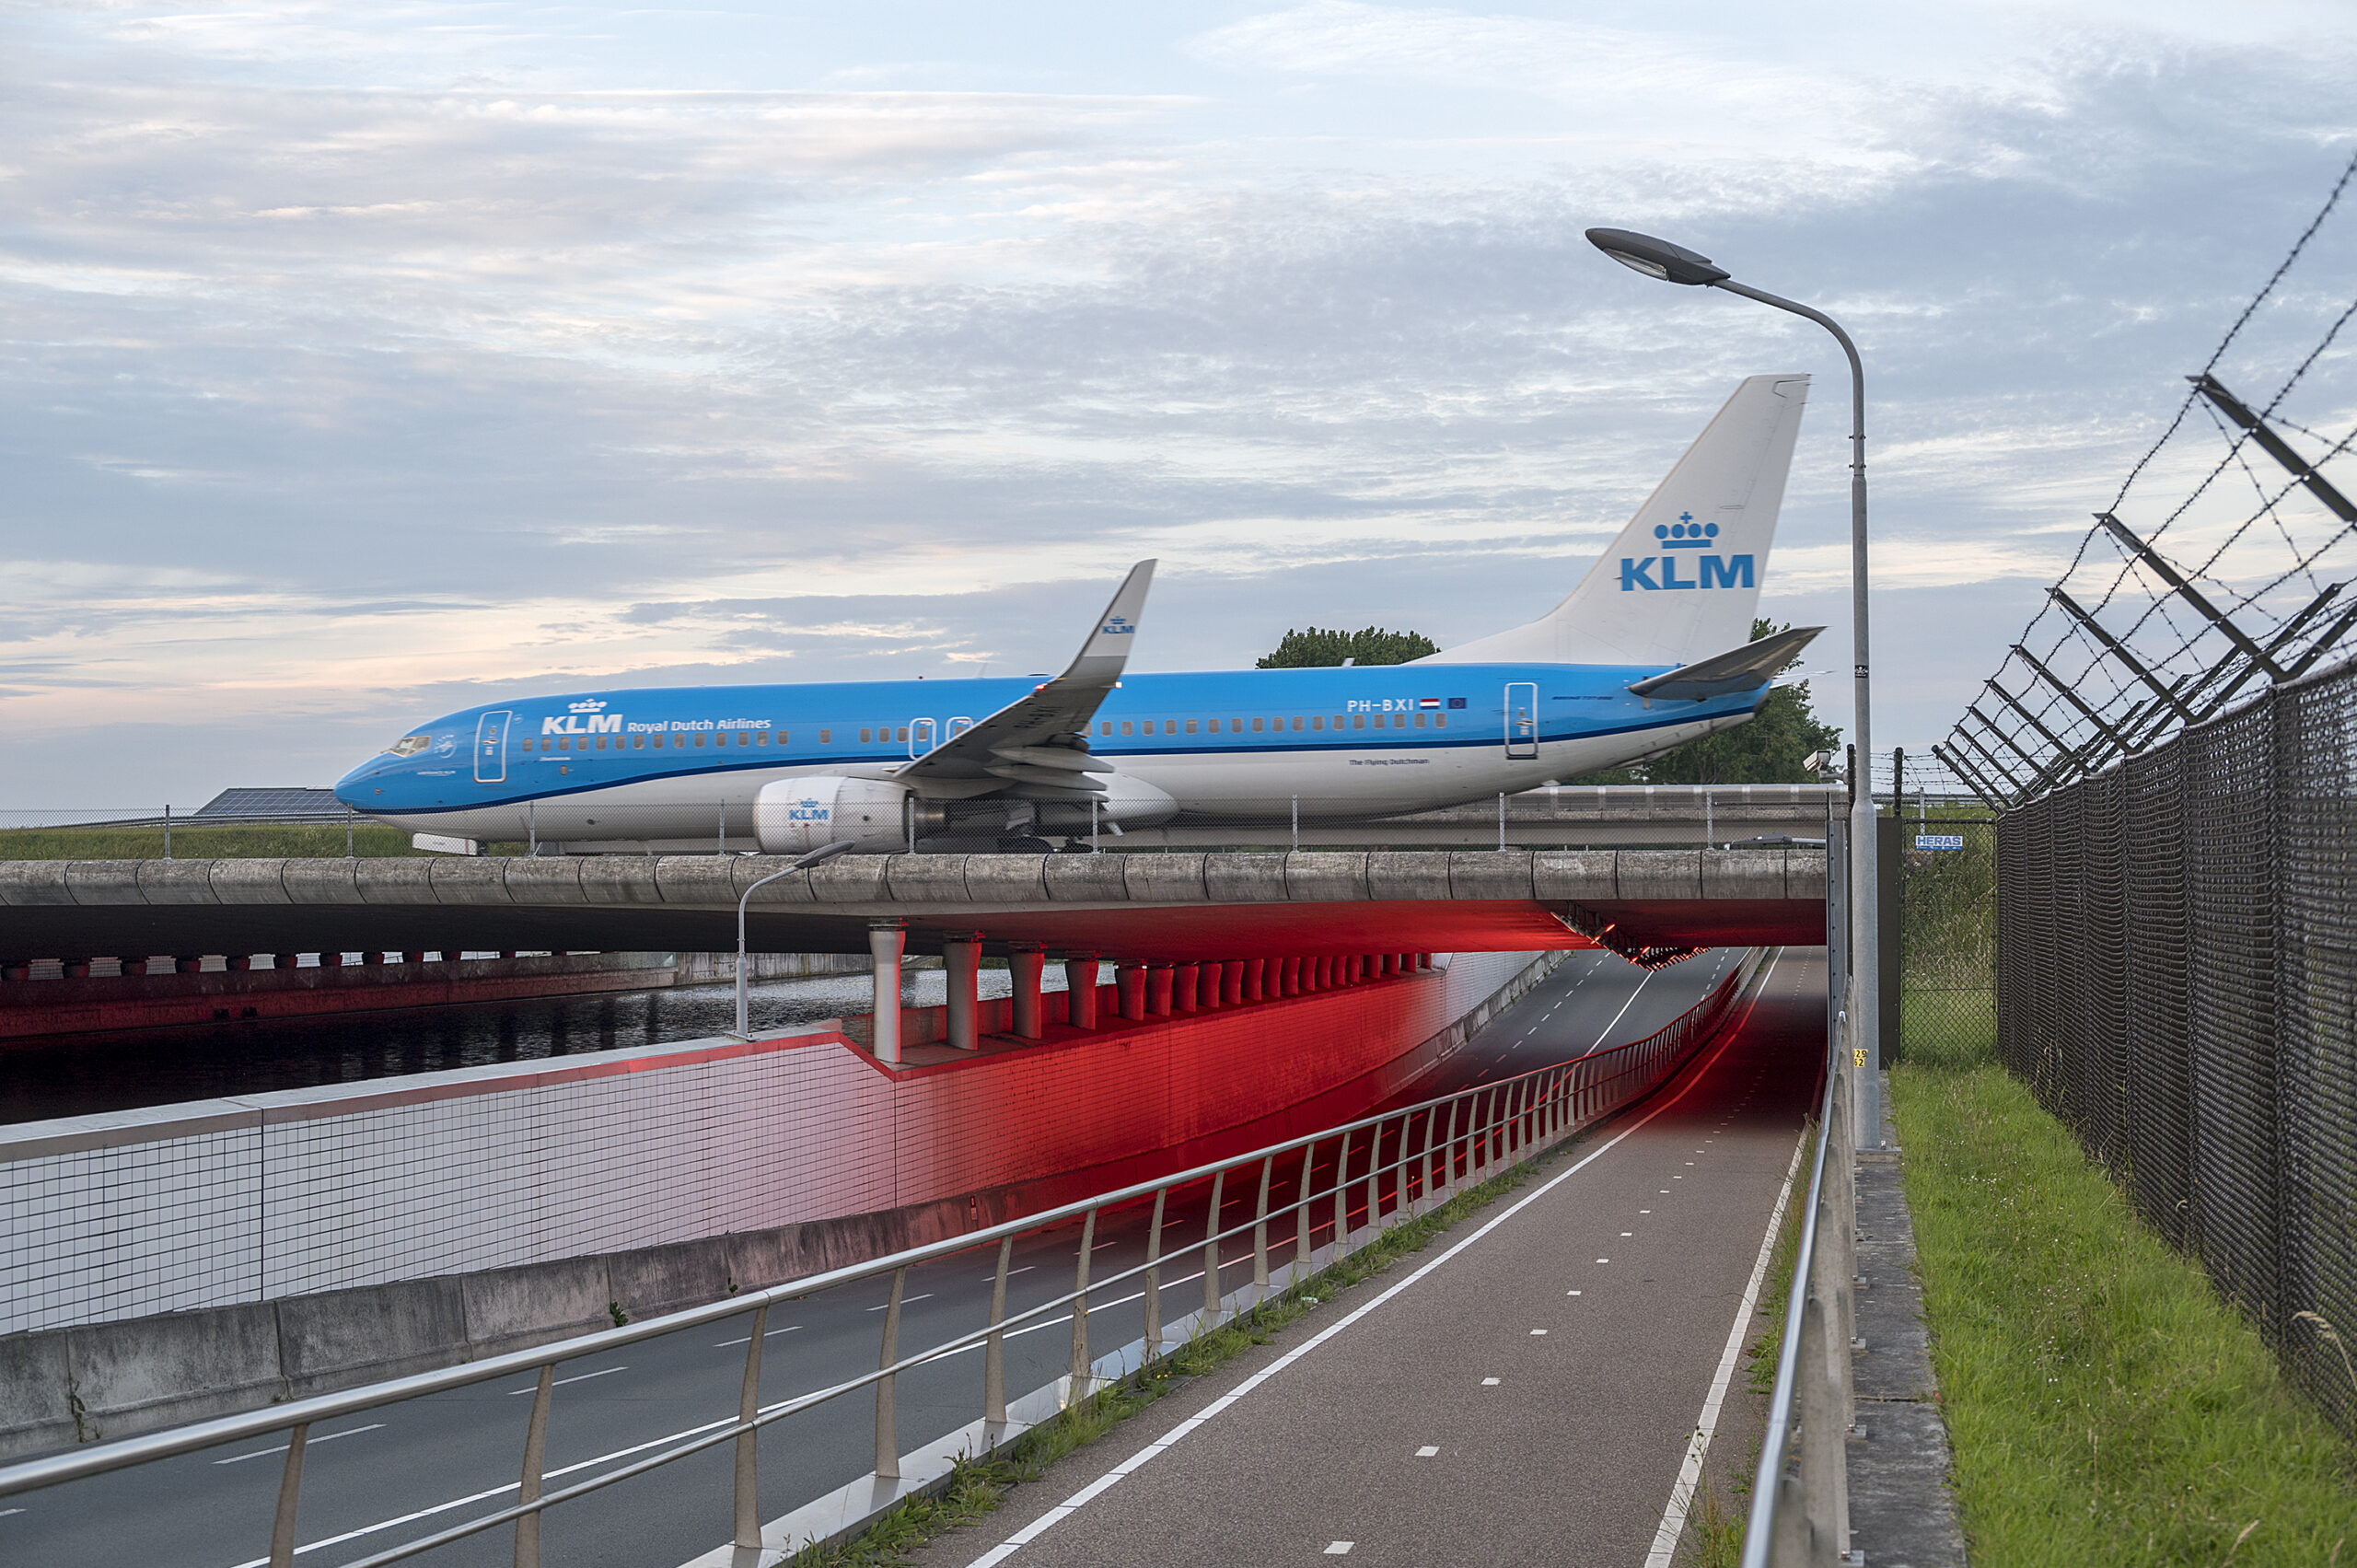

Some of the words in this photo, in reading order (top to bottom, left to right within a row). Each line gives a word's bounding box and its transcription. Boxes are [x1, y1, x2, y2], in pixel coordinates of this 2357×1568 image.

[1620, 554, 1755, 591] KLM
[1102, 625, 1135, 634] KLM
[1347, 698, 1414, 713] PH-BXI
[541, 714, 623, 735] KLM
[627, 720, 668, 734] Royal
[670, 719, 714, 731] Dutch
[716, 718, 772, 730] Airlines
[789, 809, 829, 819] KLM
[1917, 836, 1961, 845] HERAS
